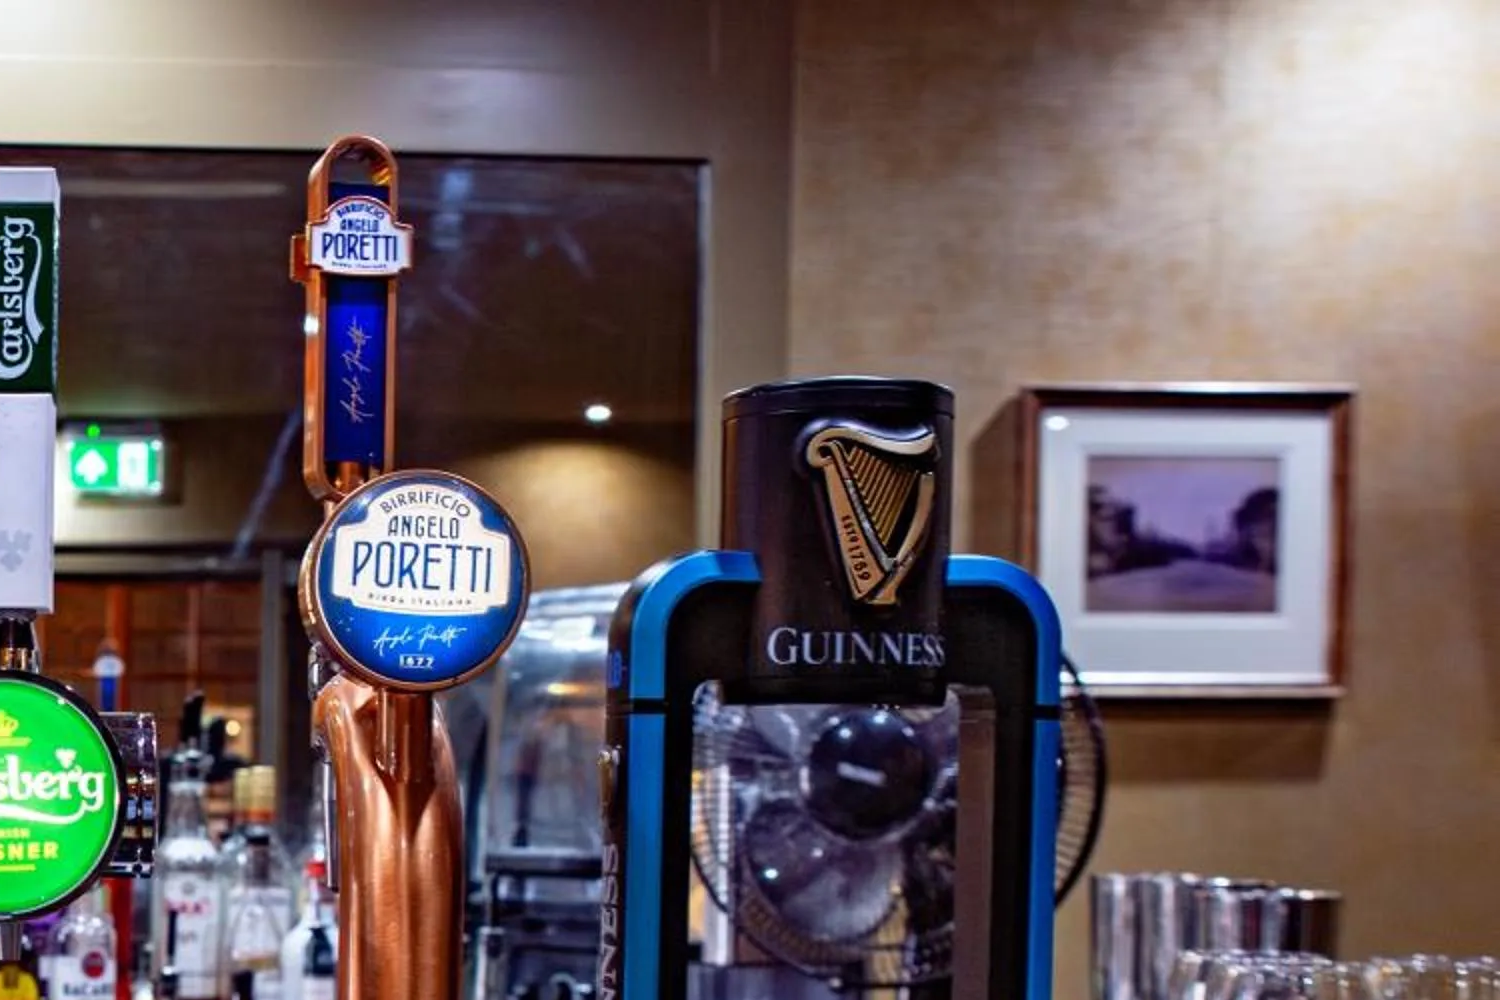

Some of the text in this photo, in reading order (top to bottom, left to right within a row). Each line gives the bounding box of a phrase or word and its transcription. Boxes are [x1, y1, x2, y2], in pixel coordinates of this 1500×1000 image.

[321, 231, 398, 262] PORETTI
[379, 491, 471, 518] BIRRIFICIO
[387, 515, 460, 539] ANGELO
[351, 540, 493, 593] PORETTI
[767, 627, 945, 666] GUINNESS
